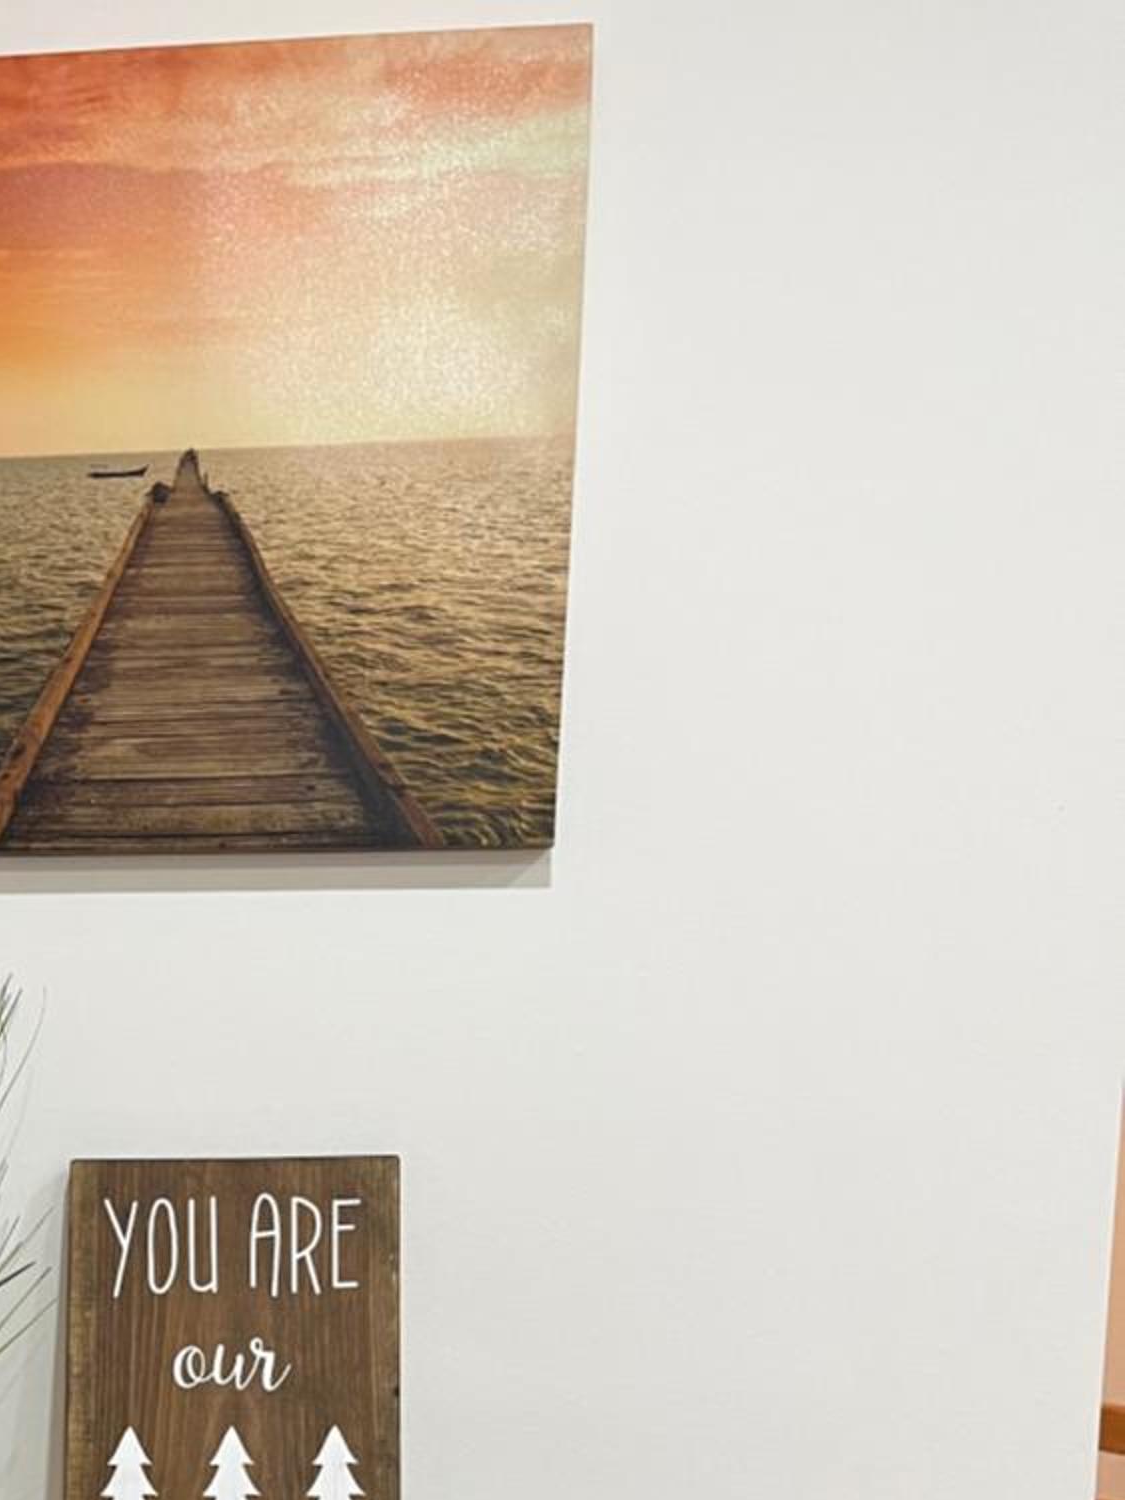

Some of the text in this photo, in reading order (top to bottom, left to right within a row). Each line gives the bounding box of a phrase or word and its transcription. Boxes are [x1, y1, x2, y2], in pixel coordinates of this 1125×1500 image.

[104, 1193, 362, 1298] YOU ARE
[172, 1337, 291, 1391] our
